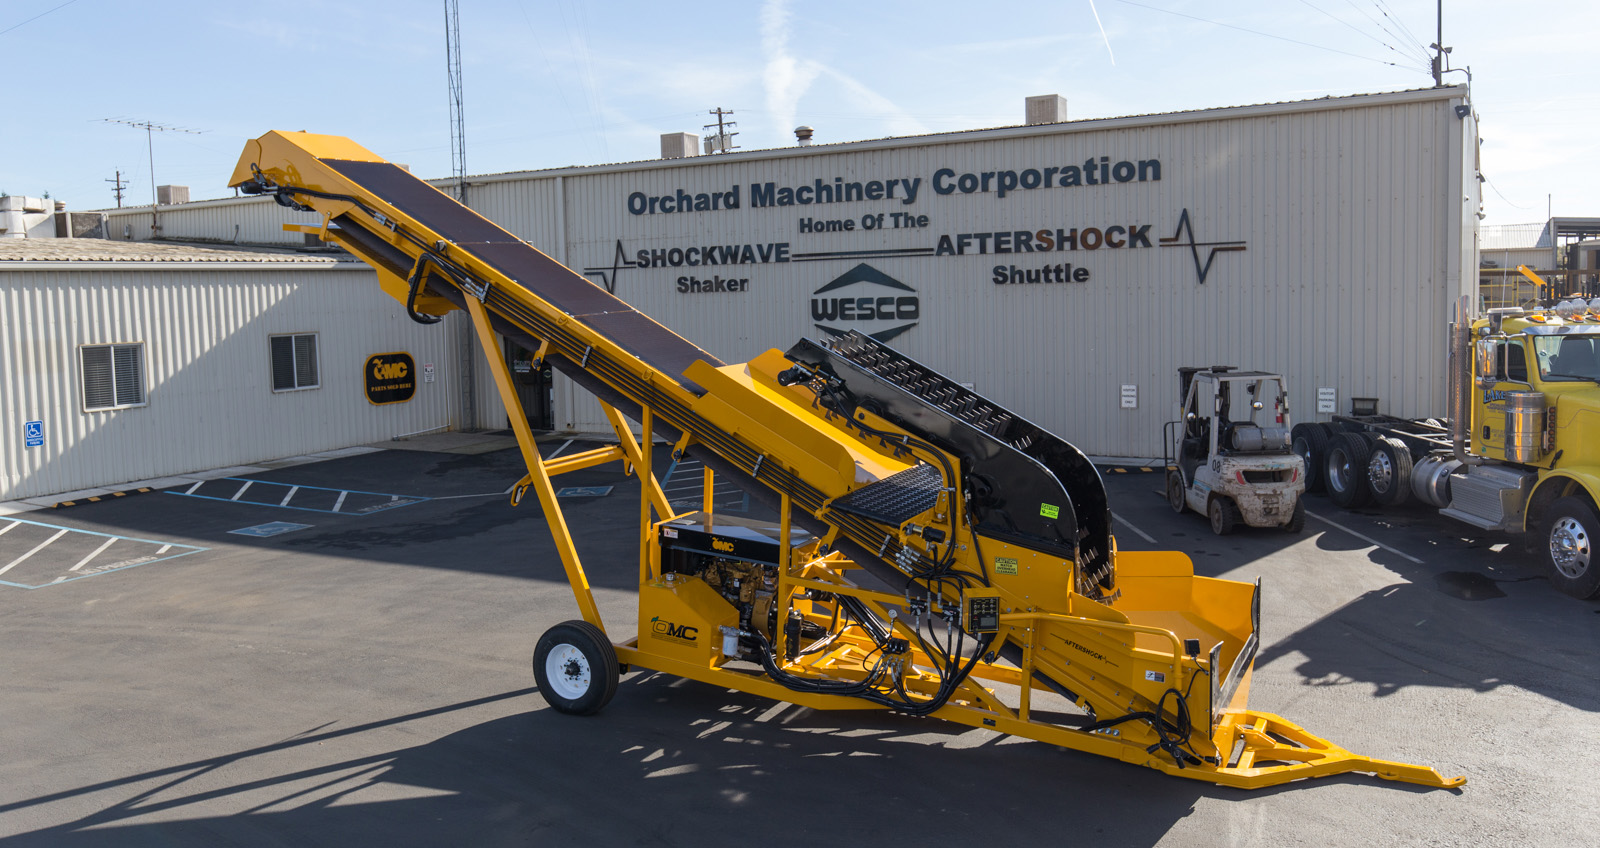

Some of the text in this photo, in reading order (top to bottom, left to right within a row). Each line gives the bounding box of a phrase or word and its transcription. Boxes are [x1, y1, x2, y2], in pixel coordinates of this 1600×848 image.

[628, 156, 1162, 215] Orchard Machinery Corporation
[800, 211, 929, 233] Home Of The
[936, 224, 1153, 257] AFTERSHOCK
[636, 242, 790, 269] SHOCKWAVE
[677, 275, 749, 294] Shaker
[992, 263, 1090, 285] Shuttle
[811, 296, 920, 322] WESCO
[373, 359, 408, 380] OMC
[1212, 460, 1221, 473] 08
[711, 537, 735, 552] OMC
[995, 557, 1018, 565] CAUTION
[652, 618, 699, 641] OMC
[1064, 639, 1103, 661] AFTERSHOCK
